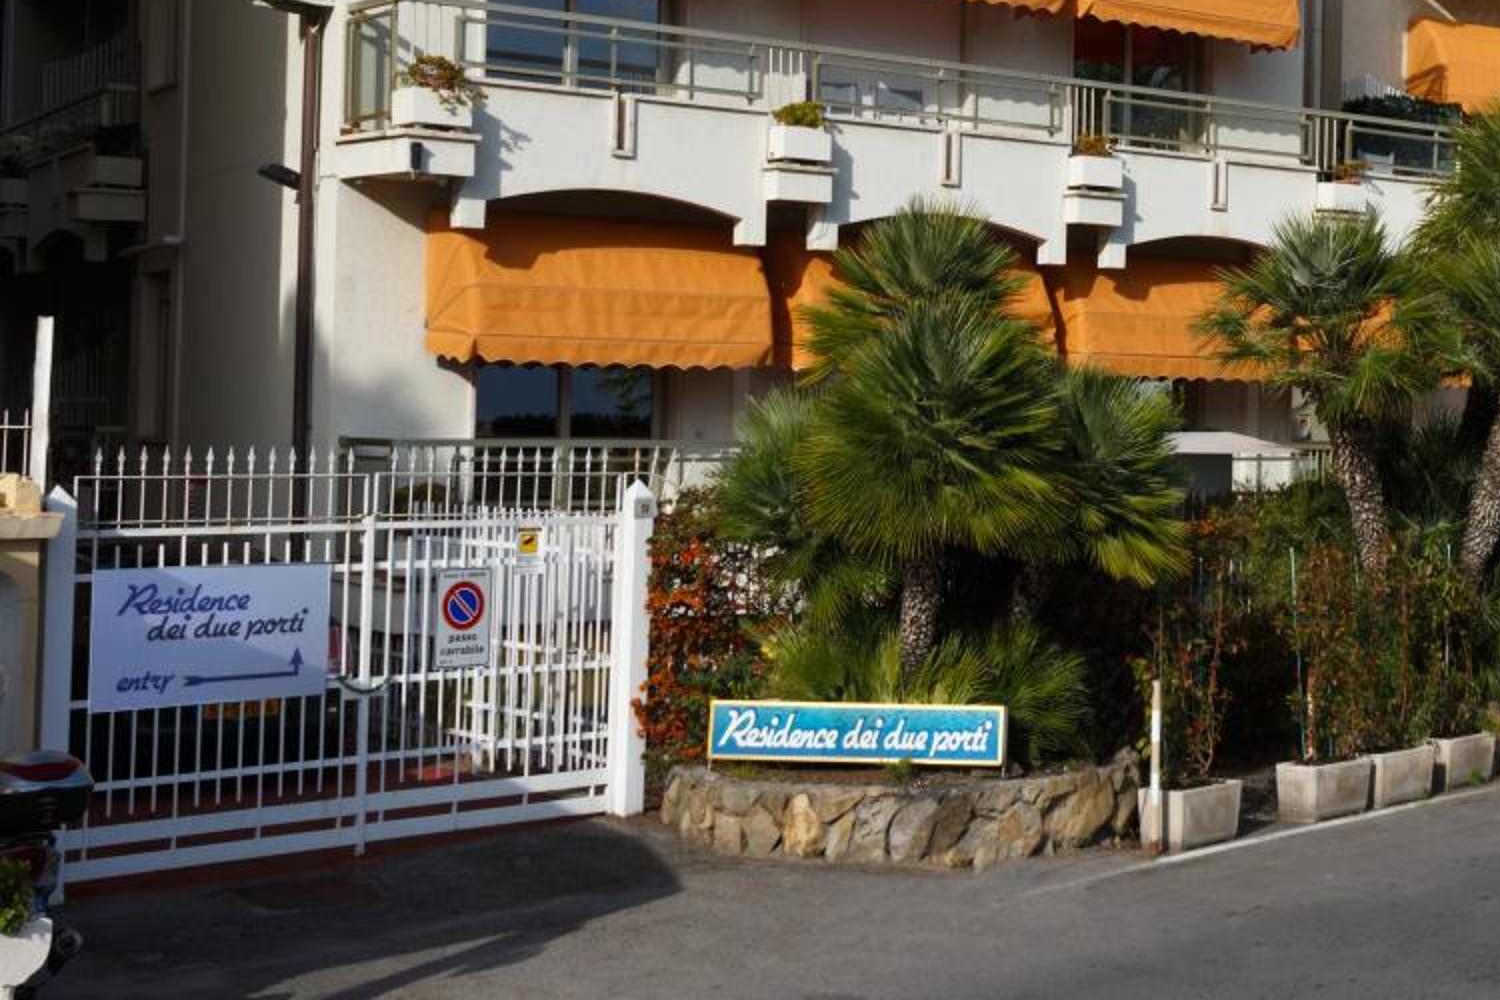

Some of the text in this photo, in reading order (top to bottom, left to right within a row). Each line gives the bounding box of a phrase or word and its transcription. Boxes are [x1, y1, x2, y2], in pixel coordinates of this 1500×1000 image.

[117, 583, 251, 617] Residence
[147, 607, 310, 642] dei due porti
[116, 671, 175, 694] entry
[718, 709, 993, 757] Residence dei due porti
